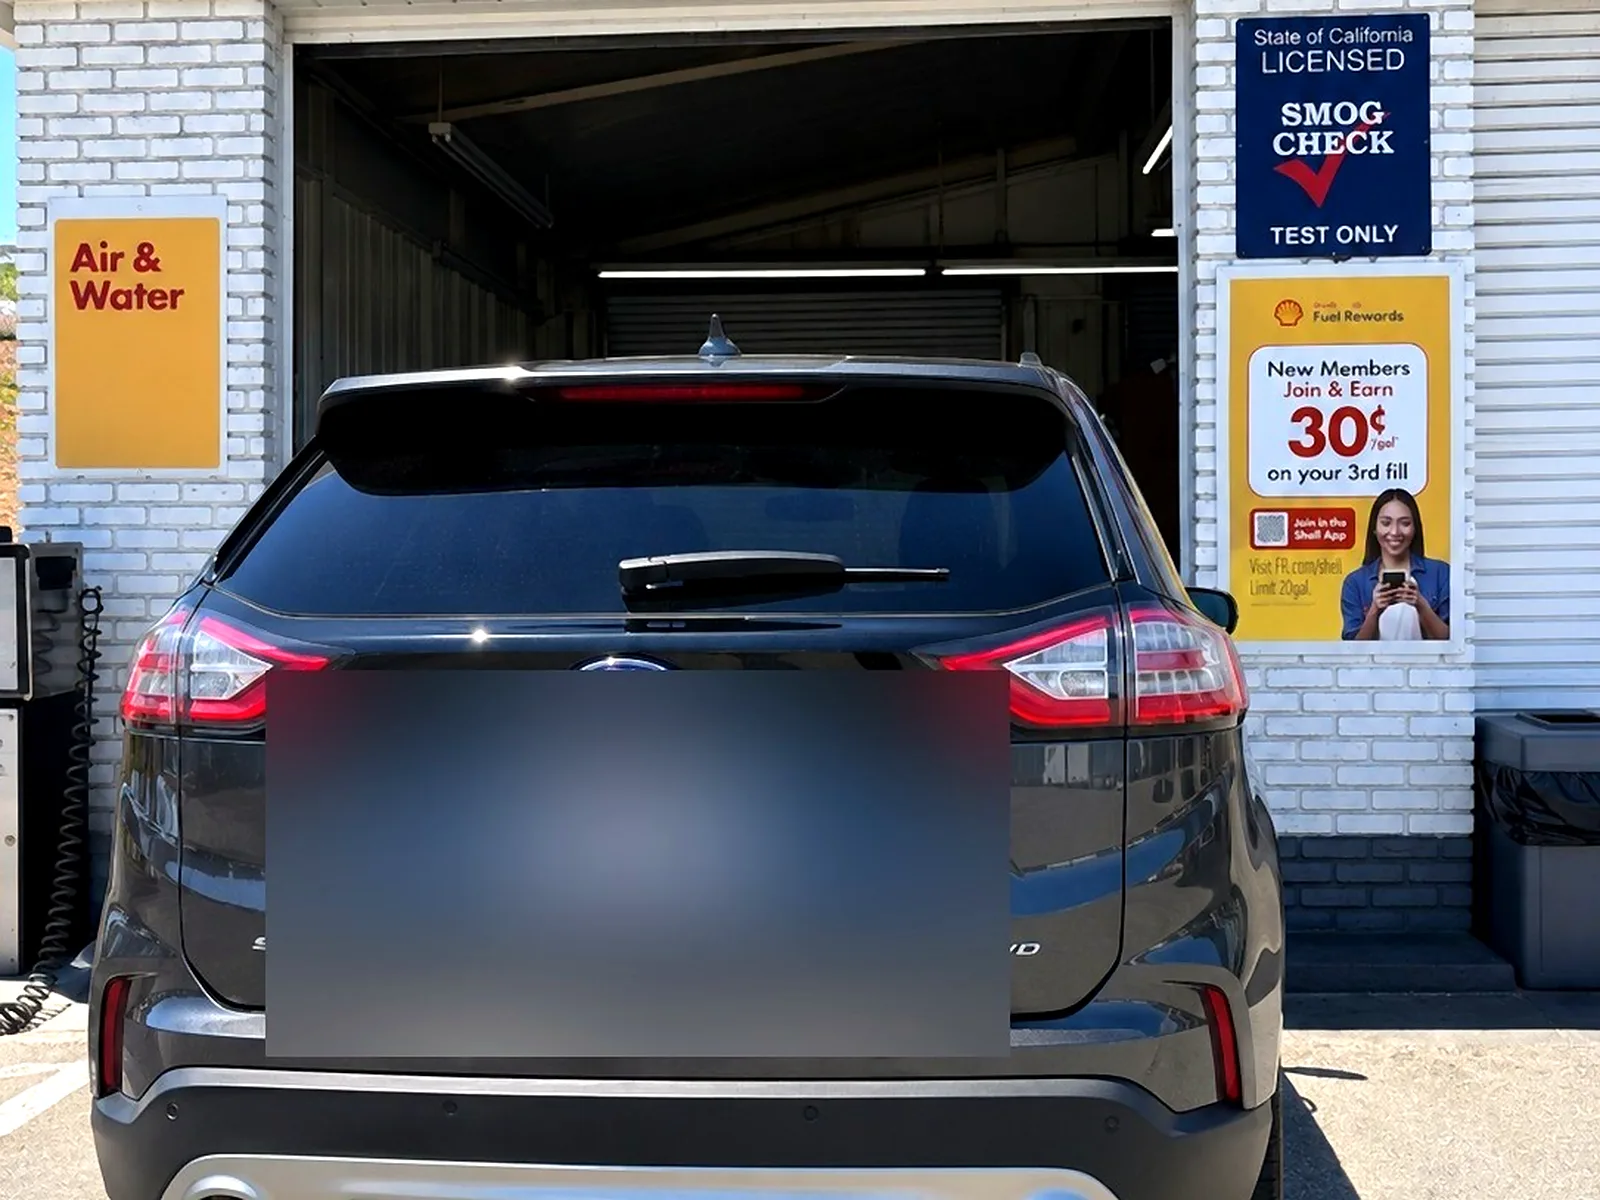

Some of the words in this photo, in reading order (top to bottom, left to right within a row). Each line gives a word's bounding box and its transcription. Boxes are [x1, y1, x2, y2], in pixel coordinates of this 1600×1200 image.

[1254, 28, 1301, 46] State
[1306, 27, 1324, 45] of
[1329, 25, 1414, 44] California
[1262, 48, 1405, 74] LICENSED
[1281, 101, 1385, 126] SMOG
[1273, 130, 1395, 156] CHECK
[1270, 226, 1330, 245] TEST
[1336, 224, 1399, 244] ONLY
[70, 240, 125, 273] Air
[133, 241, 162, 273] &
[70, 280, 185, 311] Water
[1313, 310, 1341, 323] Fuel
[1344, 309, 1404, 323] Rewards
[1267, 360, 1314, 378] New
[1320, 358, 1411, 377] Members
[1283, 381, 1321, 398] Join
[1328, 381, 1343, 398] &
[1350, 380, 1393, 397] Earn
[1267, 470, 1291, 482] on
[1298, 469, 1341, 486] your
[1348, 463, 1380, 481] 3rd
[1386, 462, 1408, 480] fill
[1323, 529, 1347, 542] App
[1250, 579, 1276, 596] Limit
